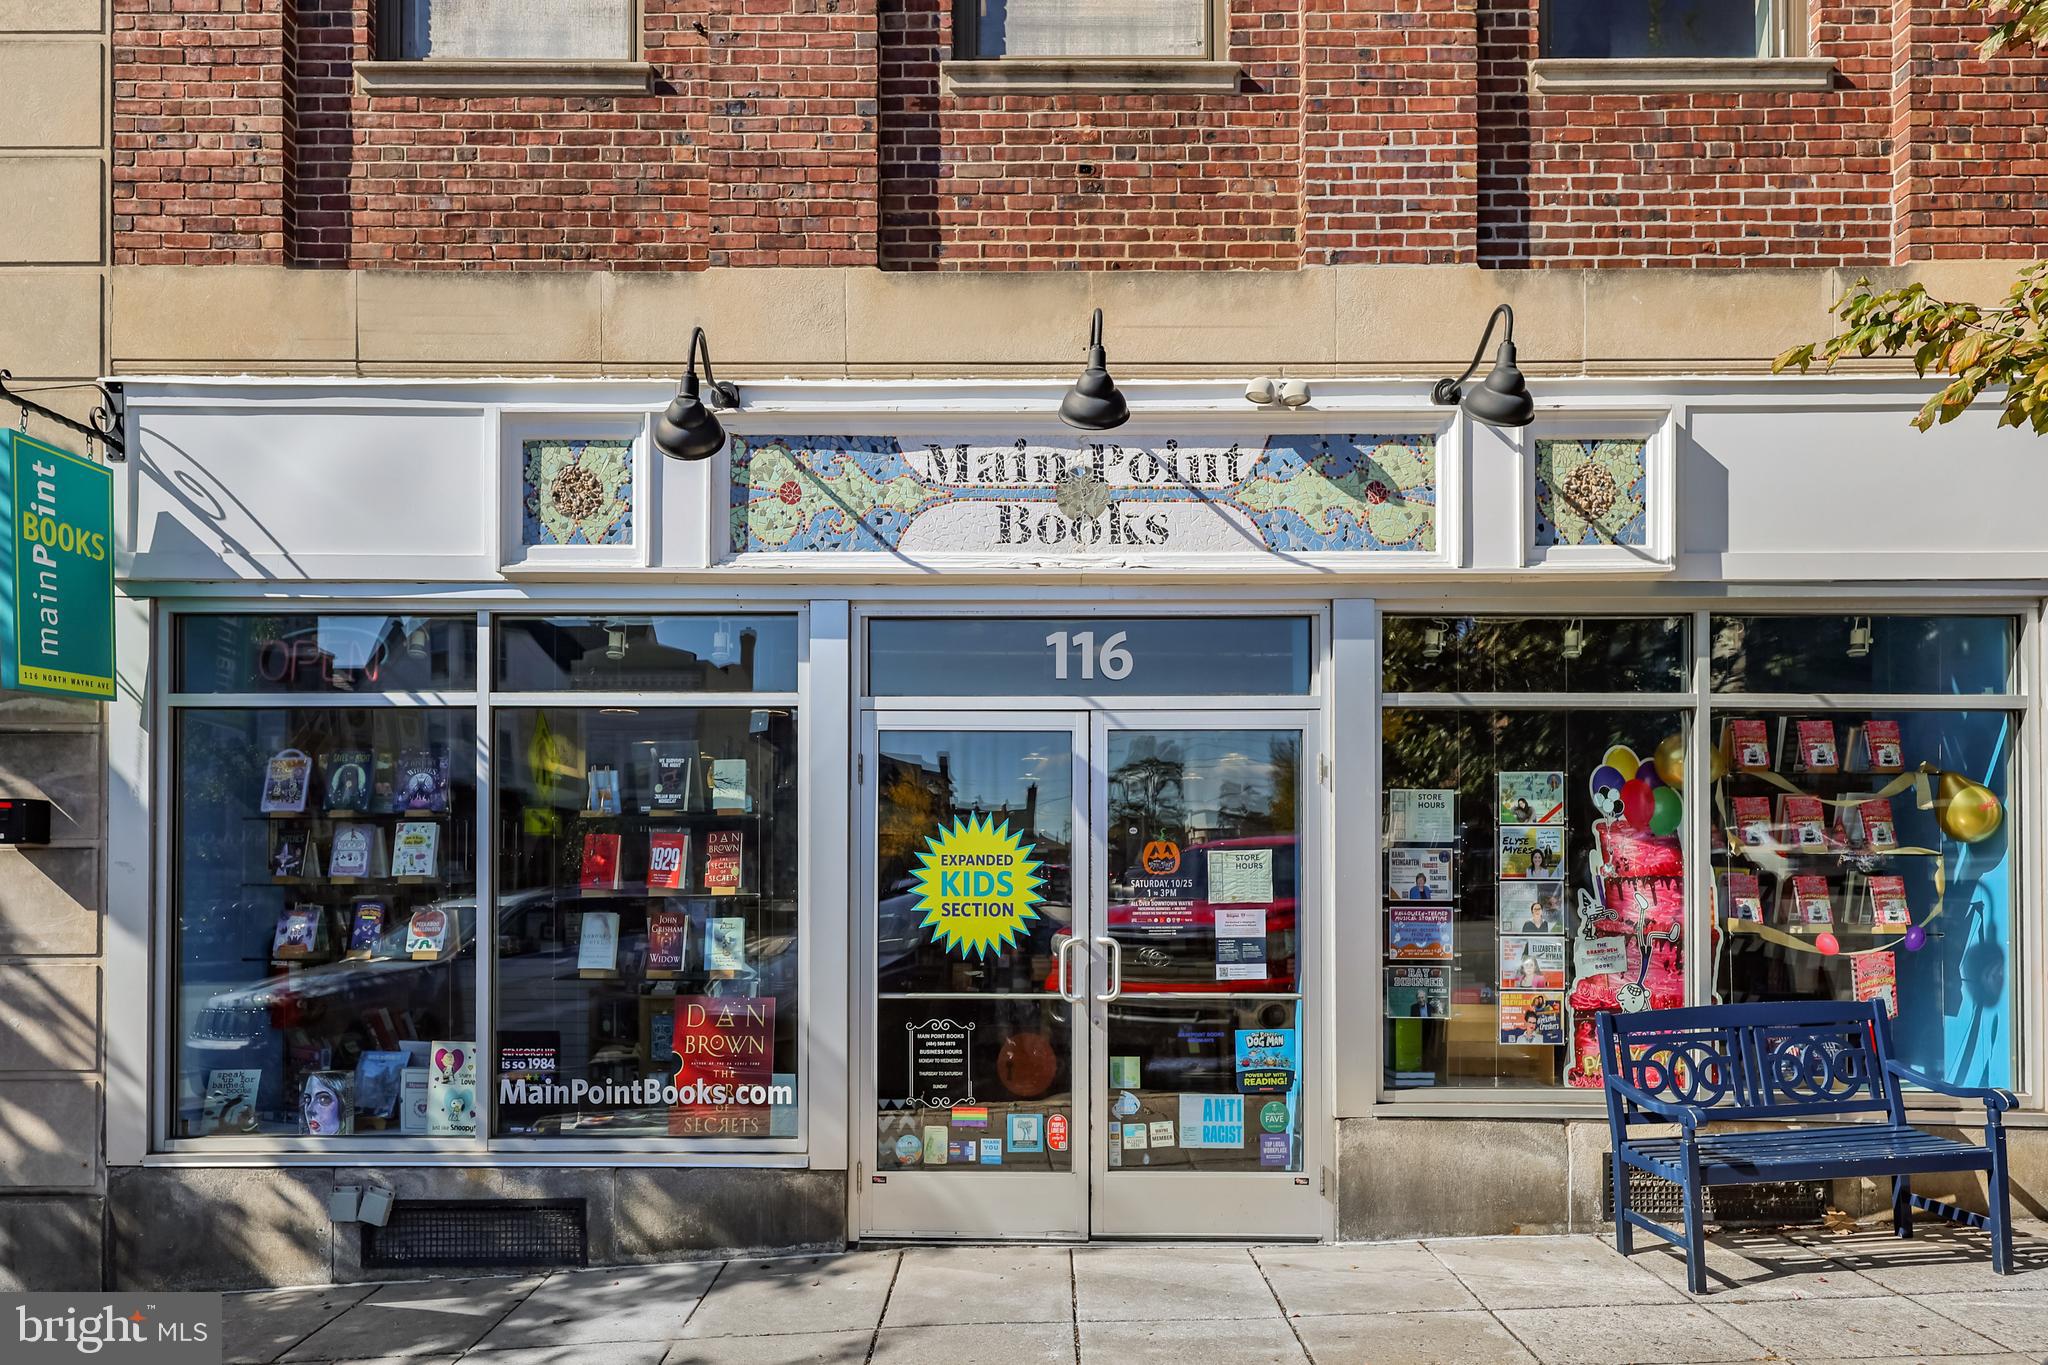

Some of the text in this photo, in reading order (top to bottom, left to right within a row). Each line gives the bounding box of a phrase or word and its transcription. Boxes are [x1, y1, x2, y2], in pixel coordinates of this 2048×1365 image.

[921, 437, 1246, 484] Main Point
[995, 500, 1170, 546] Books
[23, 511, 105, 562] BOOKS
[1045, 630, 1134, 680] 116
[258, 639, 381, 683] OPEN
[24, 672, 110, 690] 116 NORTH WAYNE AVE
[709, 833, 740, 843] DAN
[1502, 836, 1529, 845] ELYSE
[708, 844, 740, 854] BROWN
[1502, 846, 1534, 854] MYERS
[651, 847, 681, 871] 1929
[941, 854, 1014, 867] EXPANDED
[1391, 858, 1420, 866] WEINGARTEN
[711, 861, 737, 870] SECRET
[1235, 862, 1264, 870] HOURS
[708, 874, 738, 882] SECRETS
[941, 870, 1014, 897] KIDS
[1171, 880, 1193, 888] 10/25
[1147, 889, 1151, 897] 1
[941, 902, 1014, 917] SECTION
[659, 916, 678, 924] JOHN
[651, 924, 683, 934] GRISHAM
[650, 954, 680, 963] WIDOW
[1546, 952, 1563, 960] HYMAN
[1408, 968, 1430, 978] RAY
[1394, 977, 1444, 986] DIDINGER
[687, 1004, 766, 1028] DAN
[685, 1035, 765, 1057] BROWN
[1246, 1035, 1284, 1047] DOG MAN
[502, 1048, 556, 1057] CENSORSHIP
[502, 1058, 556, 1069] is so 1984
[713, 1070, 735, 1078] THE
[1244, 1078, 1288, 1086] READING!
[500, 1079, 792, 1105] MainPointBooks.com
[715, 1104, 728, 1112] OF
[1203, 1098, 1242, 1122] ANTI
[1265, 1115, 1284, 1123] FAVE
[450, 1124, 476, 1132] Snoopy!
[684, 1117, 759, 1133] SECRETS
[1203, 1125, 1243, 1143] RACIST
